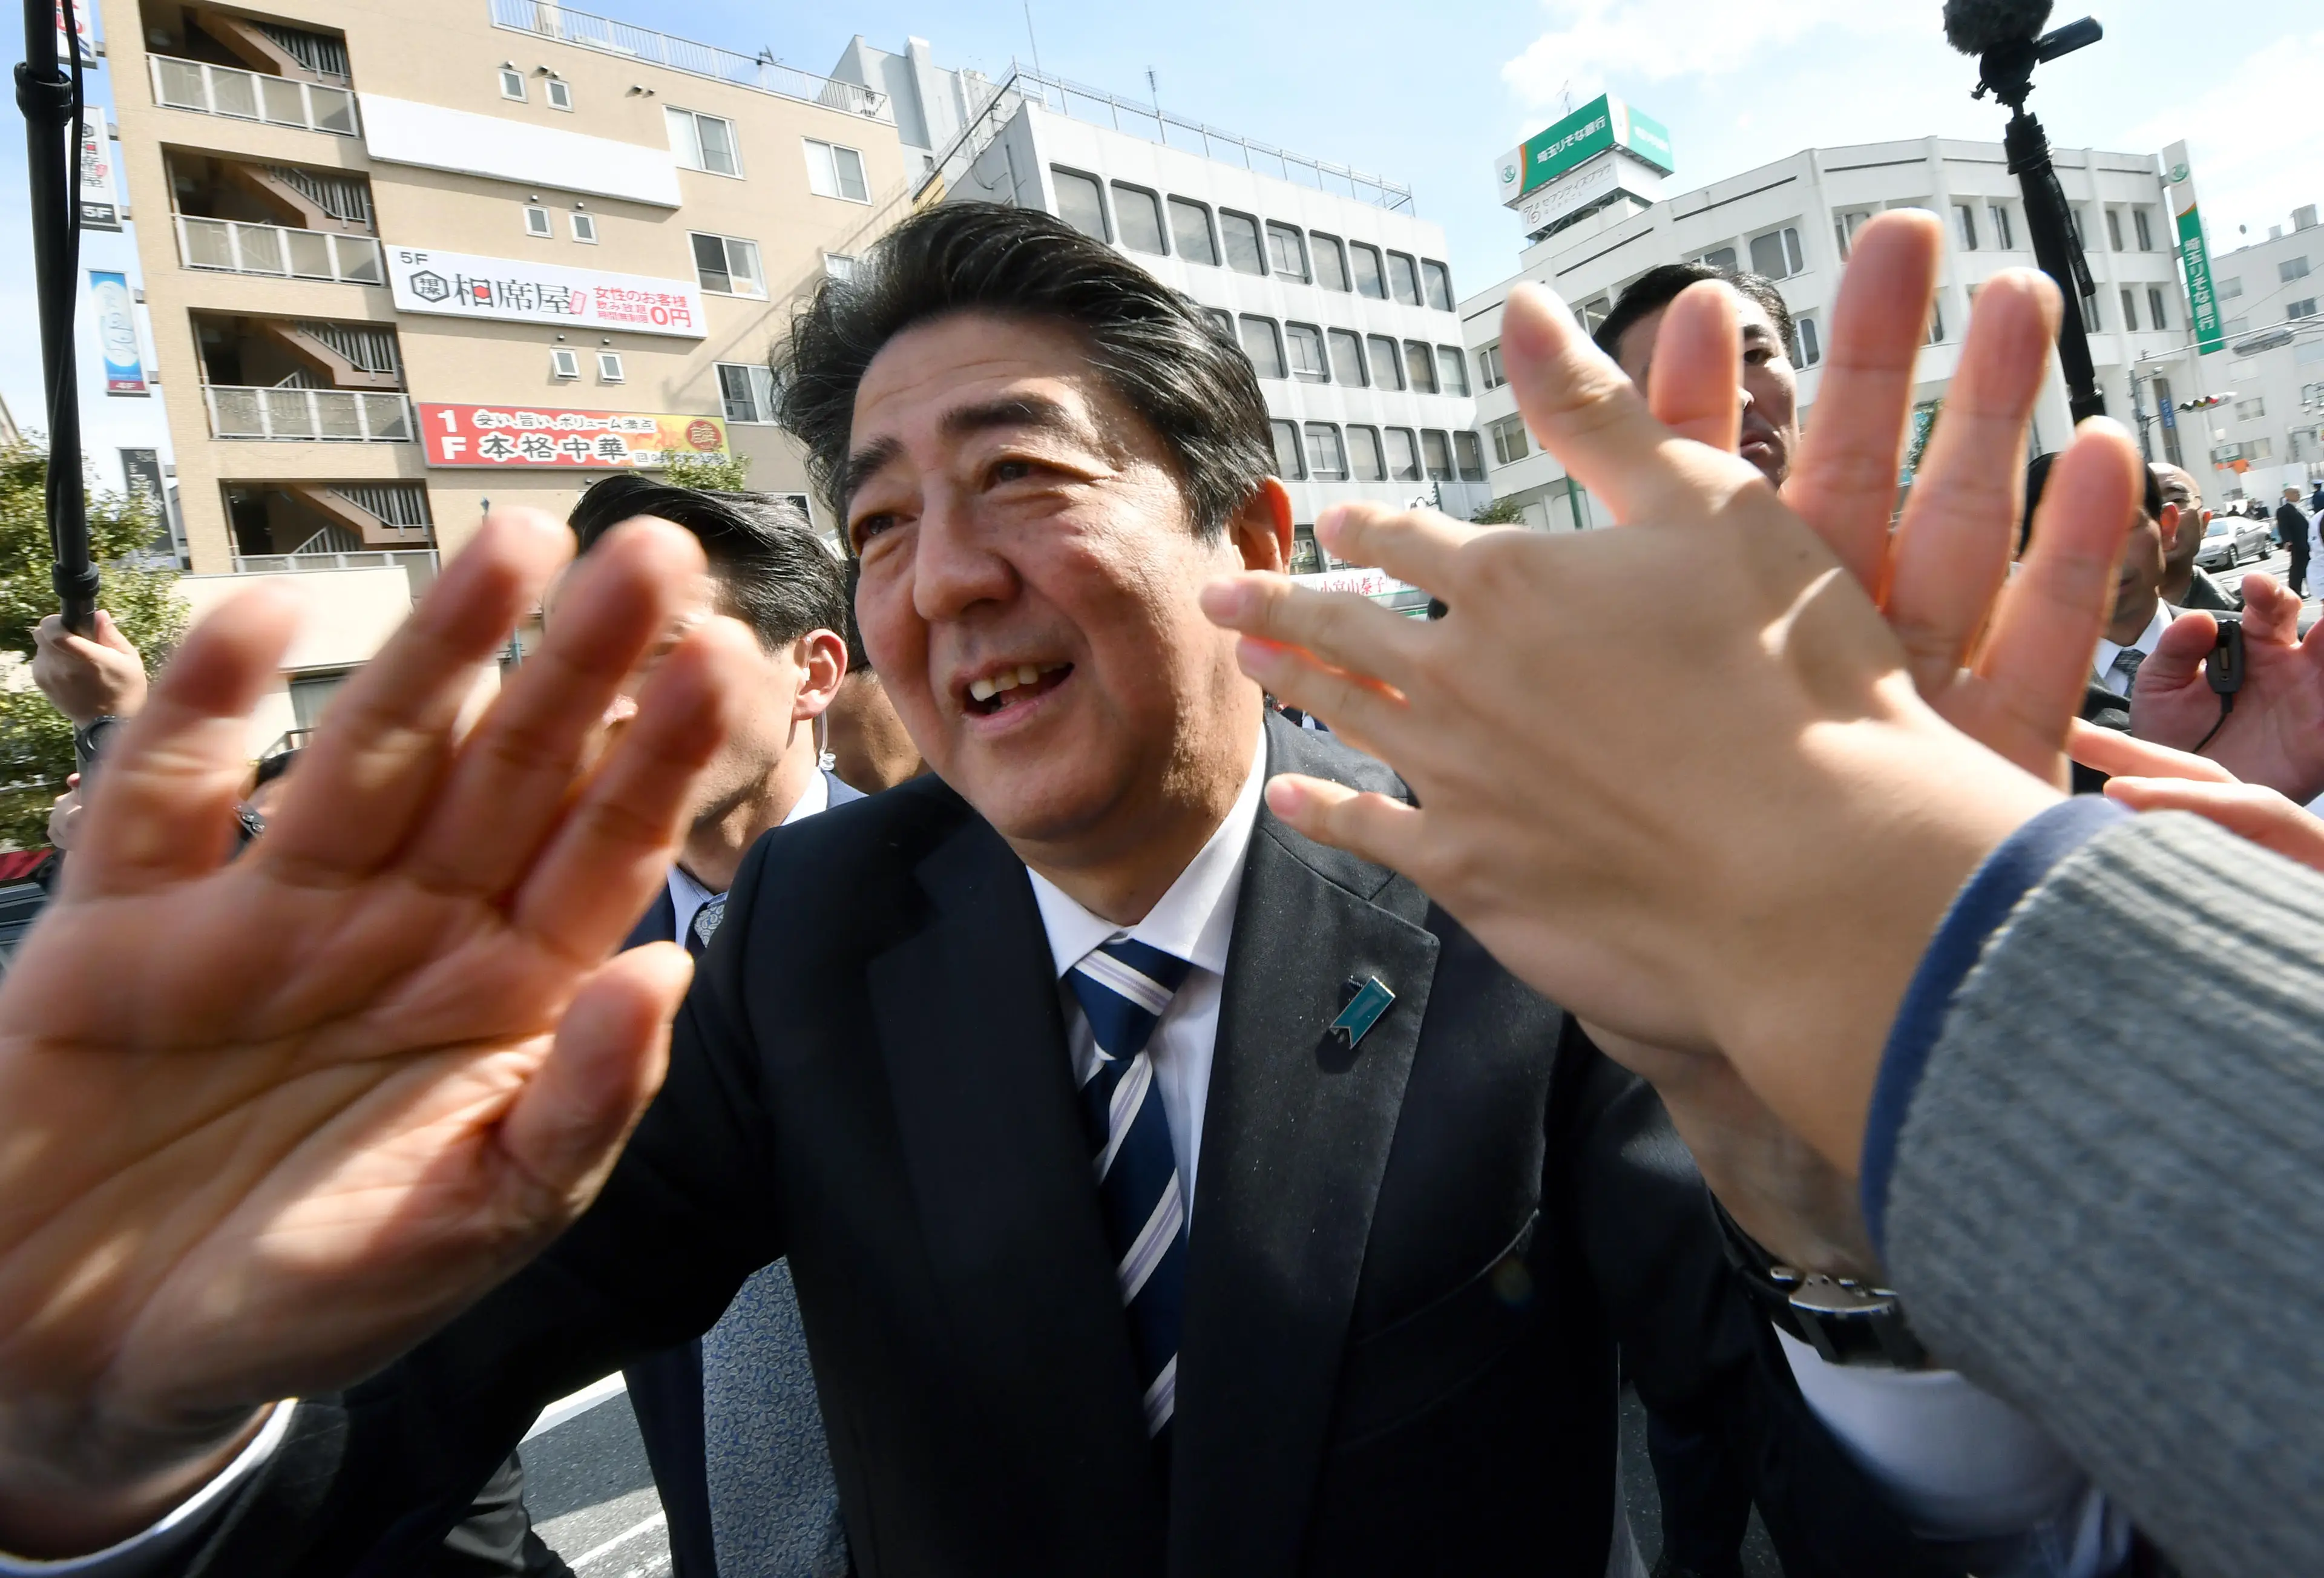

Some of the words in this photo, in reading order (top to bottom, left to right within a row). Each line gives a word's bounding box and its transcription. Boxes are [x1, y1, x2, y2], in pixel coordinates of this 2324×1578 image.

[82, 205, 113, 219] 5F
[400, 251, 428, 265] 5F
[450, 273, 576, 315] 相席屋
[593, 286, 688, 308] 女性のお客様
[596, 300, 648, 314] 飲み放題
[651, 306, 692, 328] 0円
[483, 435, 628, 461] 本格中華
